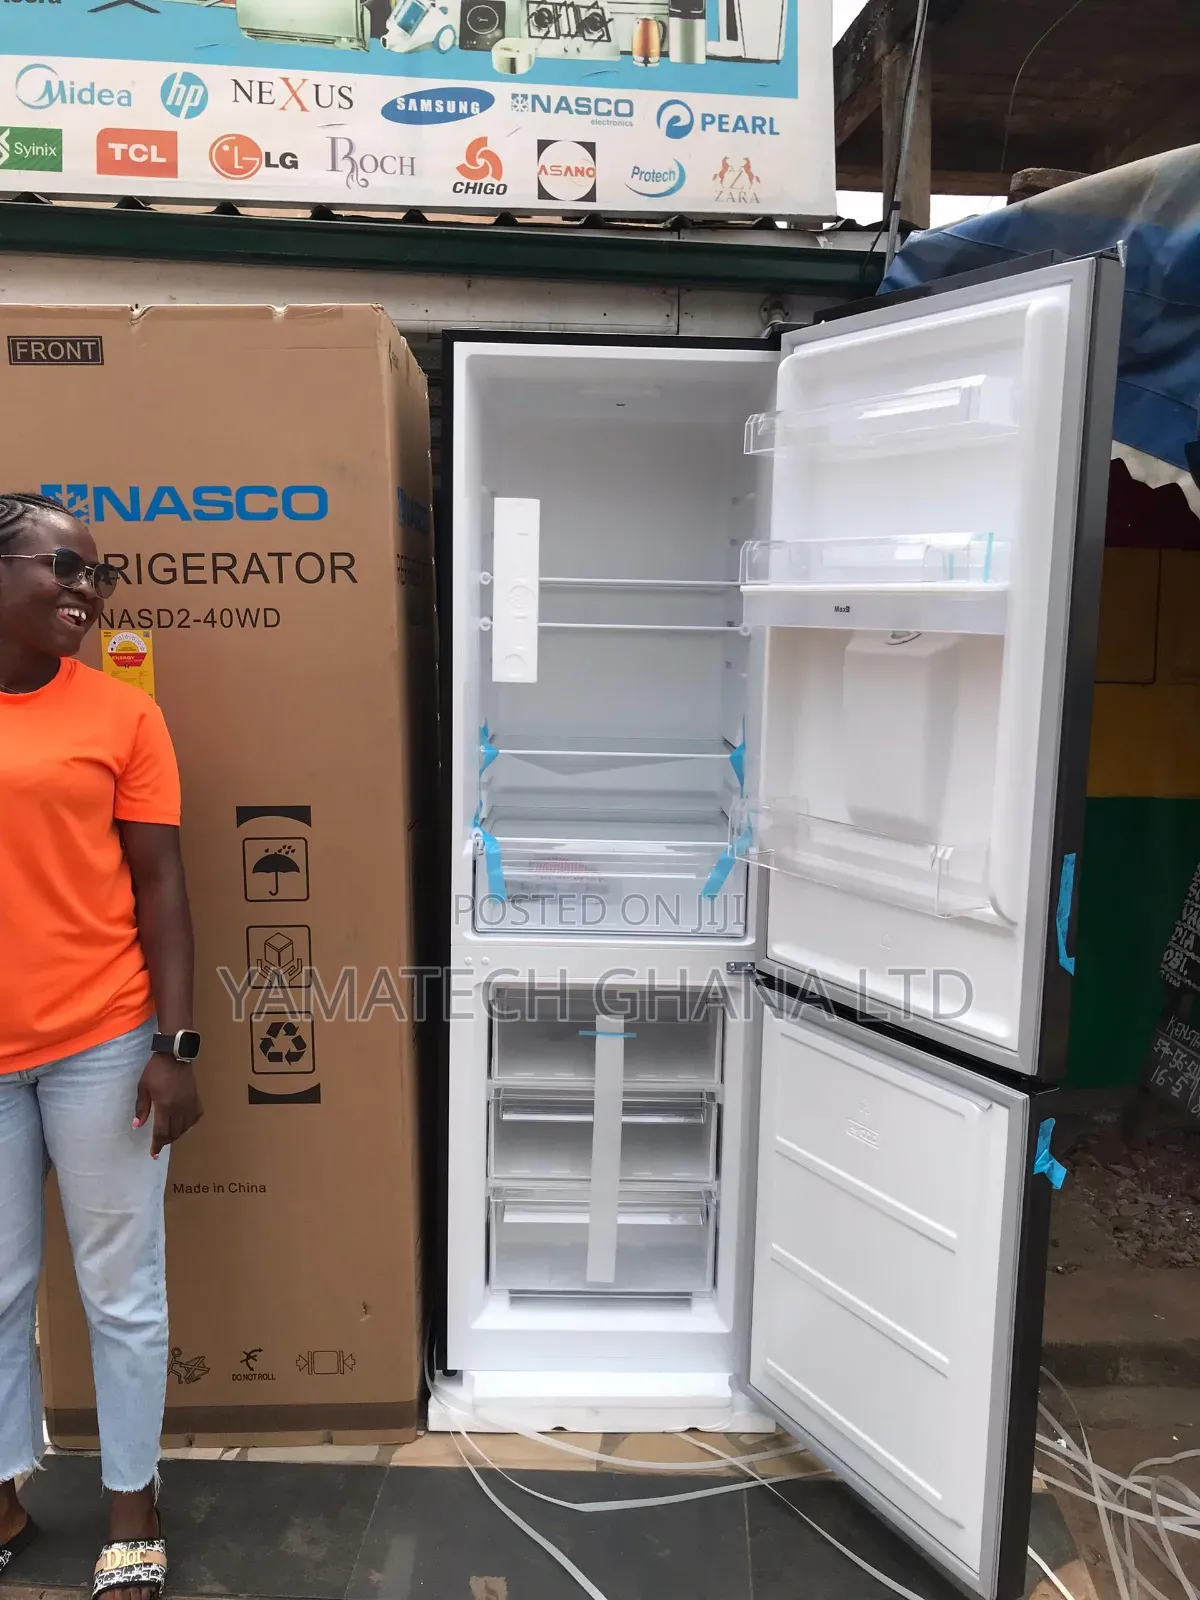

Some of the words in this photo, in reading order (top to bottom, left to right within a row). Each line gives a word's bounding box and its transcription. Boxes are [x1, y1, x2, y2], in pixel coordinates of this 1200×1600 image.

[38, 79, 132, 108] Midea
[164, 72, 205, 119] hp
[231, 77, 354, 112] NEXUS
[396, 97, 480, 115] SAMSUNG
[531, 93, 634, 118] NASCO
[590, 117, 634, 128] electronics
[701, 112, 780, 136] PEARL
[13, 142, 57, 159] Syinix
[108, 142, 167, 163] TCL
[264, 152, 299, 170] LG
[538, 164, 596, 179] ASANO
[630, 165, 677, 185] Protech
[452, 181, 508, 195] CHIGO
[713, 189, 760, 204] ZARA
[15, 341, 97, 361] FRONT
[92, 485, 328, 522] NASCO
[103, 551, 359, 585] RIGERATOR
[173, 1183, 209, 1194] Made
[213, 1183, 224, 1193] in
[228, 1182, 266, 1193] China
[104, 1548, 145, 1570] Dior
